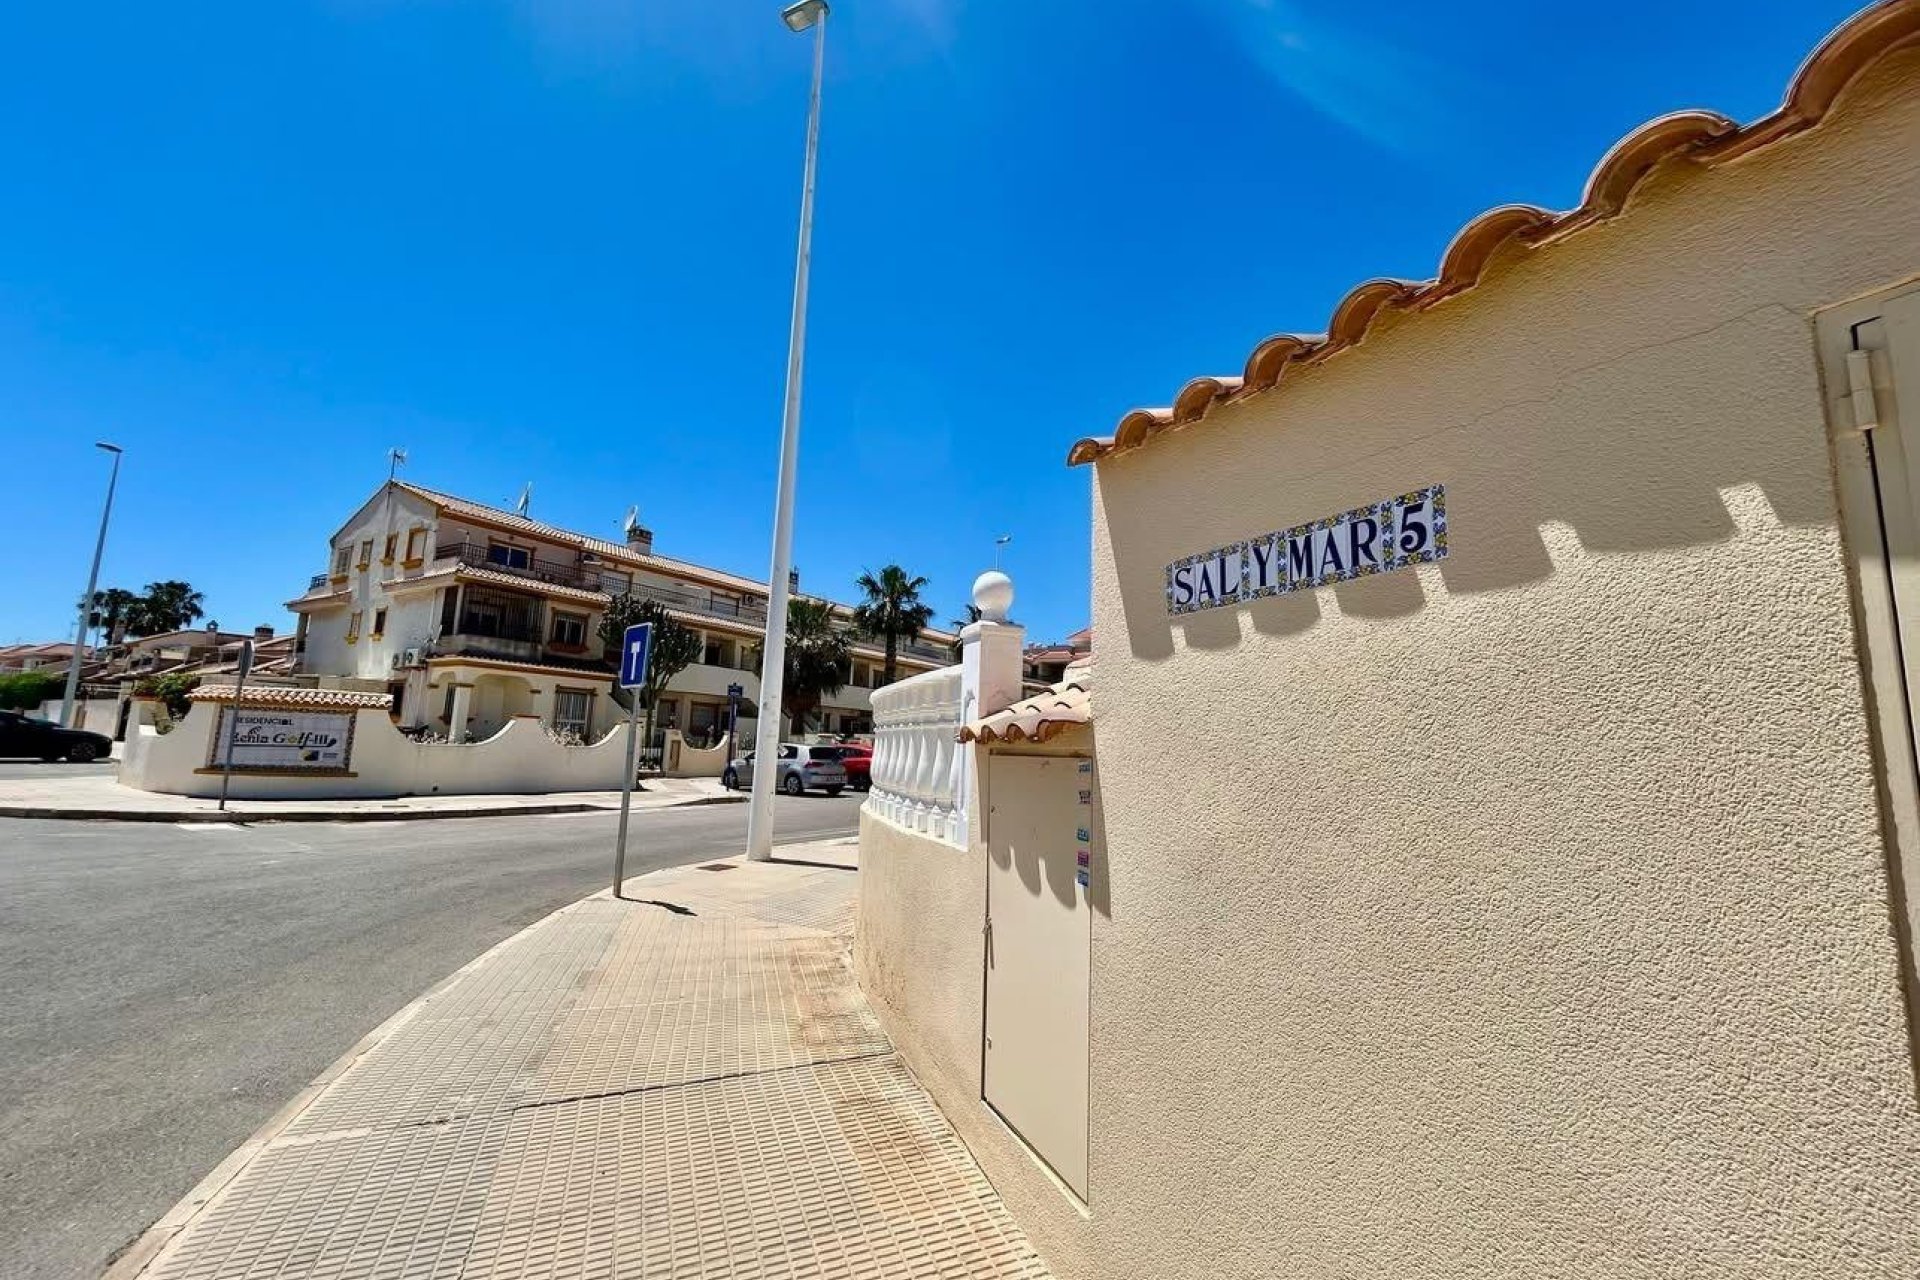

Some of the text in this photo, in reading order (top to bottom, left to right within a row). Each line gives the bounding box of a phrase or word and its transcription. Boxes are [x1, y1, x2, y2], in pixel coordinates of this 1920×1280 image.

[1174, 501, 1428, 605] SAL Y MAR 5
